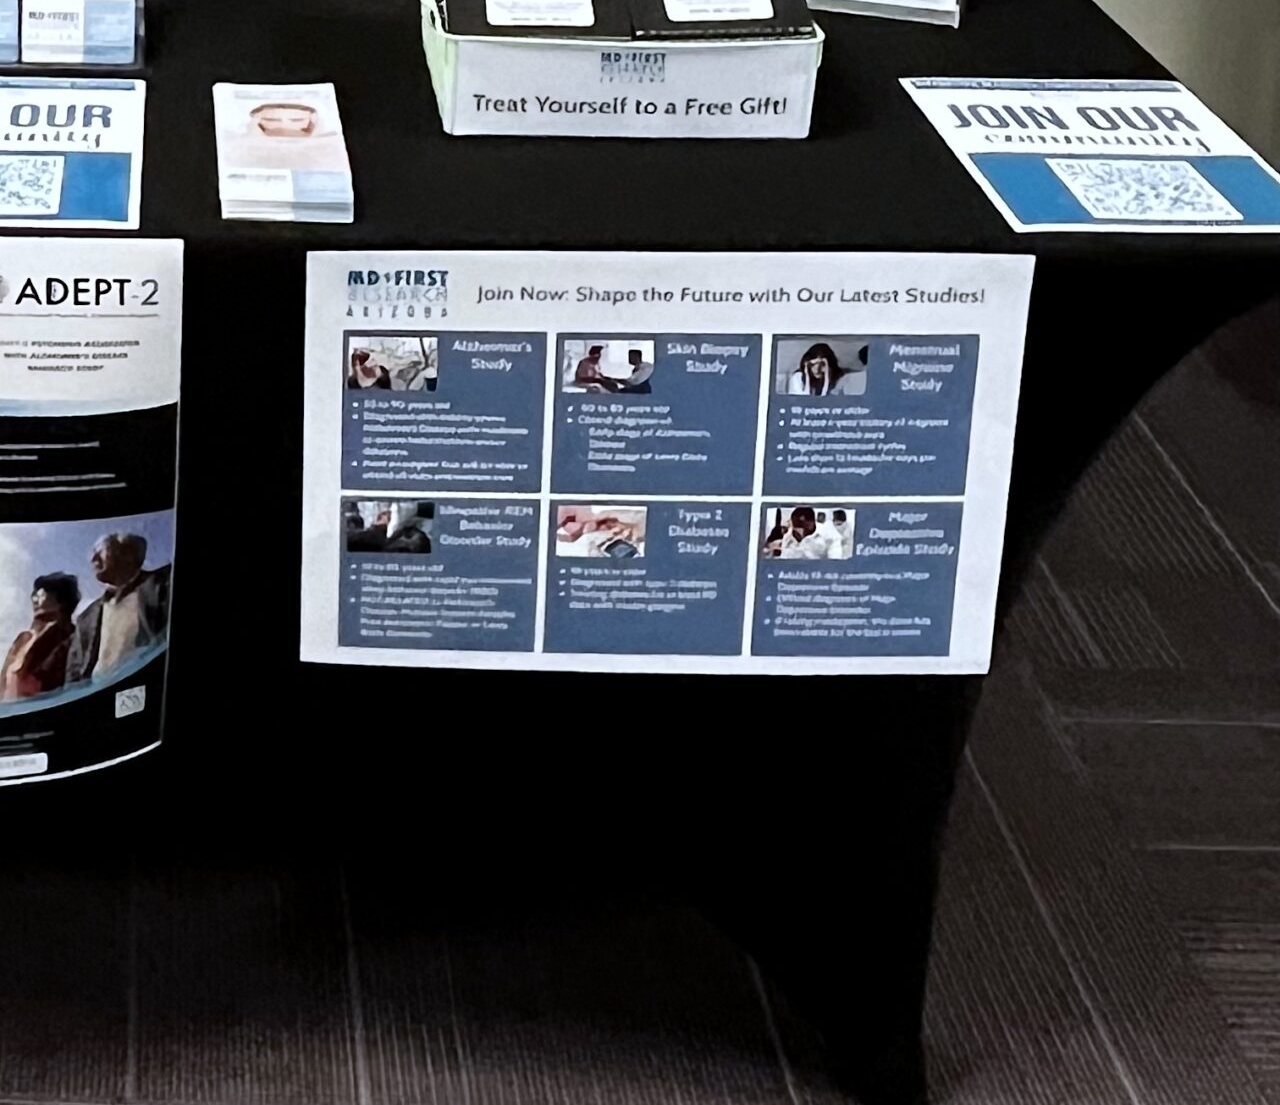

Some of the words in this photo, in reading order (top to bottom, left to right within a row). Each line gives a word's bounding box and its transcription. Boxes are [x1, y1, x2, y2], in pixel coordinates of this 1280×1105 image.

[473, 94, 528, 113] Treat
[535, 95, 629, 115] Yourself
[635, 97, 658, 115] to
[664, 101, 677, 115] a
[684, 98, 733, 116] Free
[740, 97, 788, 116] Gift!
[9, 103, 113, 129] OUR
[947, 103, 1070, 131] JOIN
[1075, 106, 1201, 132] OUR
[347, 270, 381, 286] MD
[394, 270, 449, 287] FIRST
[15, 277, 160, 306] ADEPT-2
[476, 285, 514, 303] Join
[520, 286, 569, 303] Now:
[576, 286, 637, 306] Shape
[642, 287, 674, 303] the
[681, 287, 743, 303] Future
[749, 288, 791, 303] with
[796, 287, 834, 303] Our
[839, 288, 899, 303] Latest
[905, 287, 986, 304] Studies!
[667, 343, 697, 355] Skin
[889, 344, 960, 356] Menstrual
[471, 358, 513, 372] Study
[686, 360, 728, 375] Study
[900, 378, 943, 393] Study
[678, 509, 711, 523] Type
[715, 510, 724, 521] 2
[668, 525, 730, 538] Diabetes
[496, 535, 532, 549] Study
[677, 542, 719, 556] Study
[914, 543, 955, 556] Study
